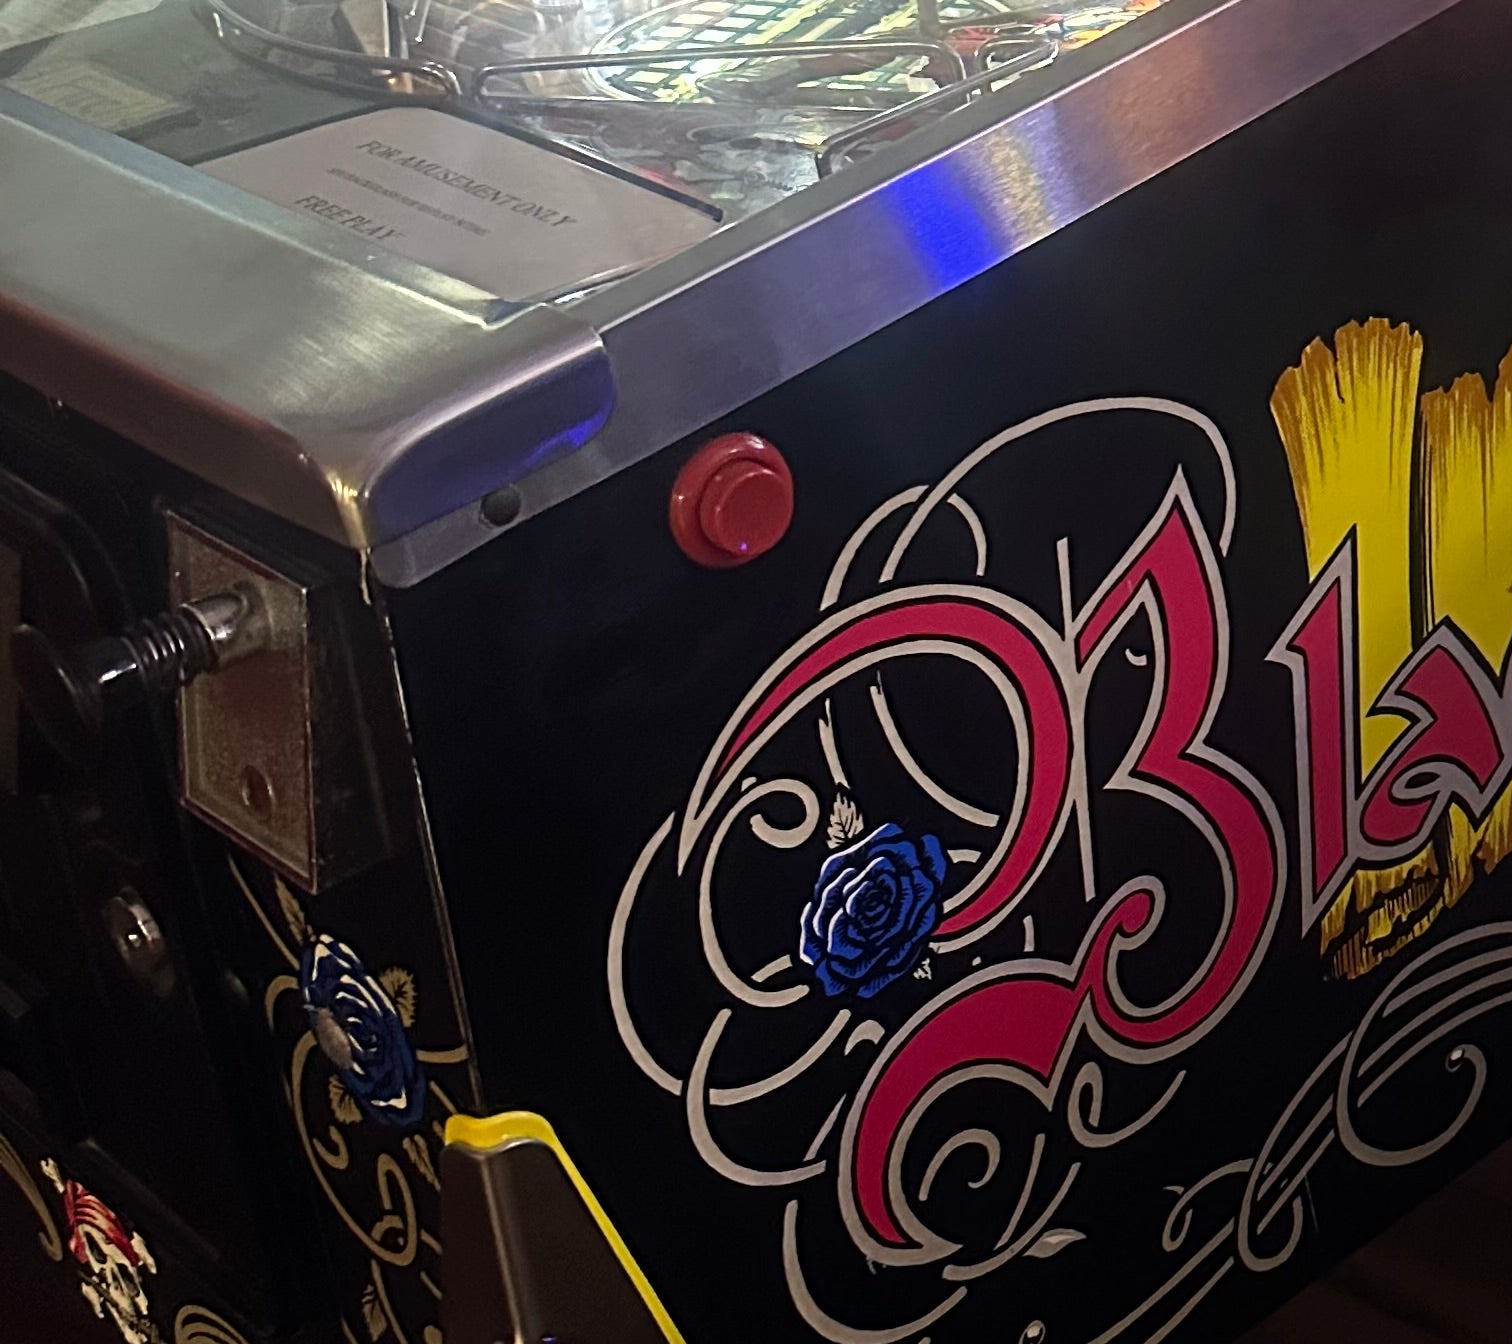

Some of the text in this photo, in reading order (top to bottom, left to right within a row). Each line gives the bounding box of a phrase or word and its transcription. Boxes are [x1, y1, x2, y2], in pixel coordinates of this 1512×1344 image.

[355, 140, 402, 162] FOR
[400, 155, 515, 205] AMUSEMENT
[510, 197, 578, 227] ONLY
[295, 195, 405, 241] FREE PLAY
